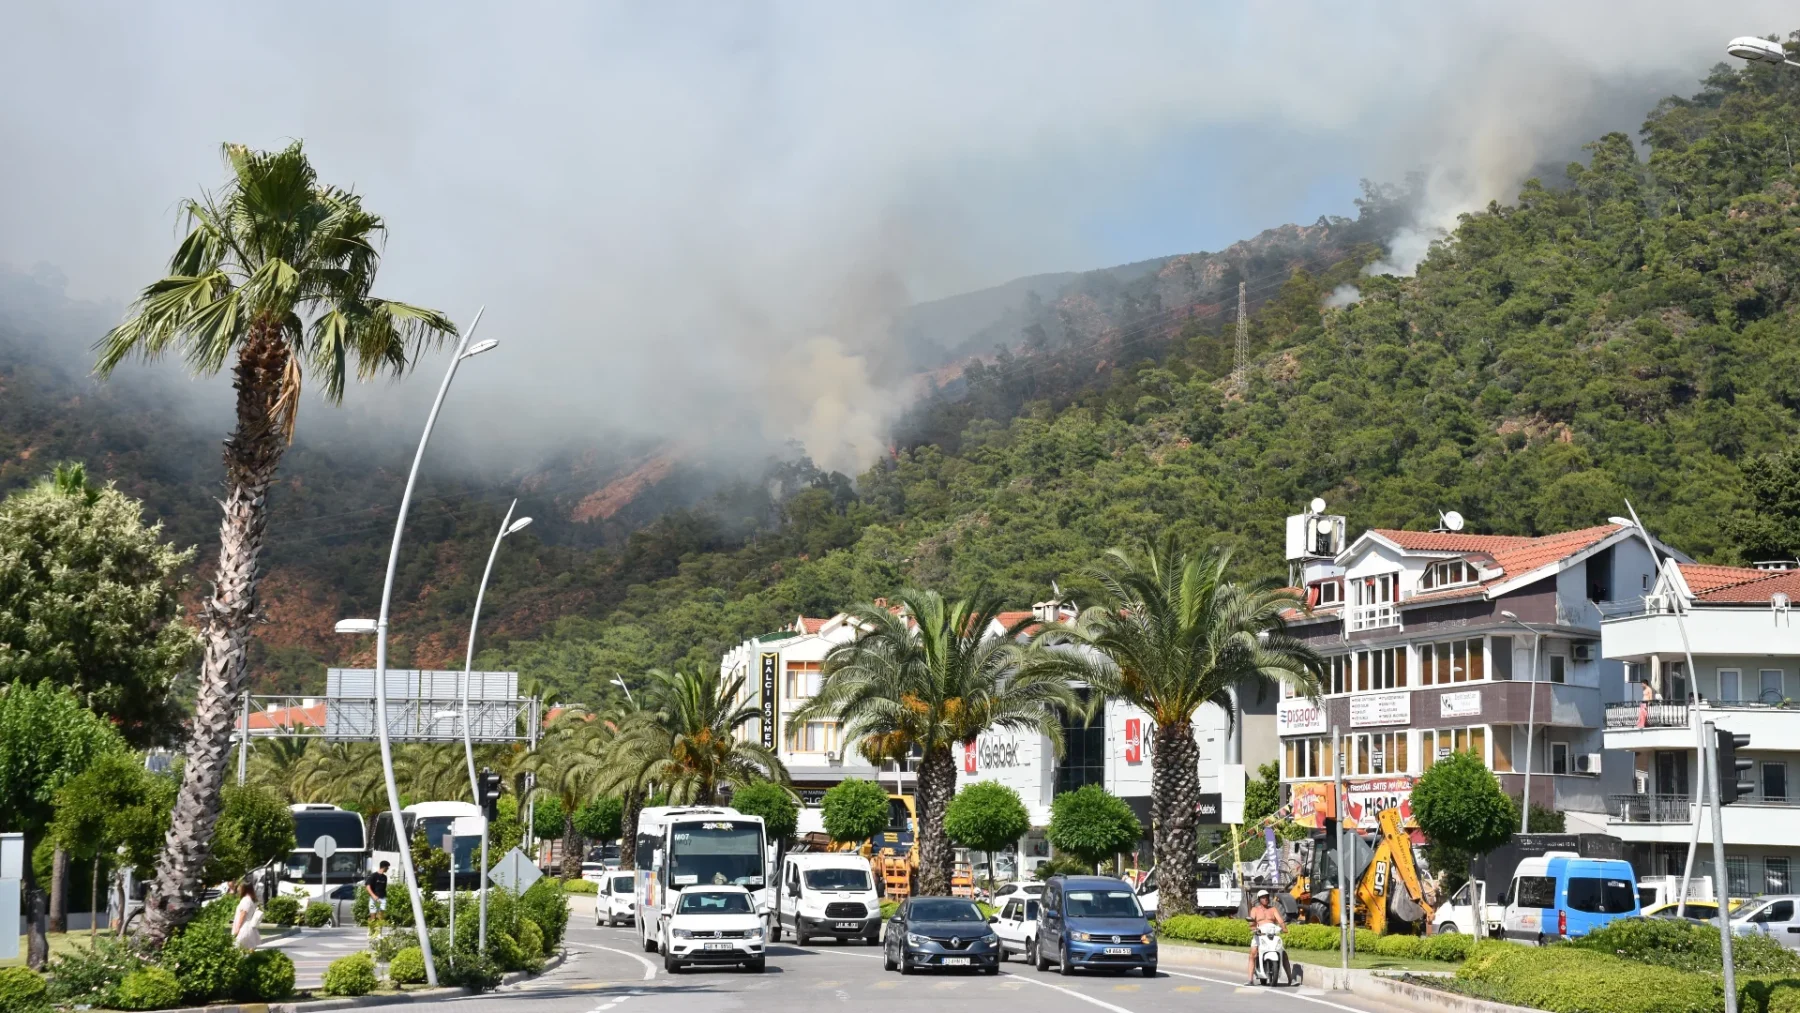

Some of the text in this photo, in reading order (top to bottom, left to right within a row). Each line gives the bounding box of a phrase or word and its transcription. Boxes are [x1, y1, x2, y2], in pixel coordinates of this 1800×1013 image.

[764, 702, 772, 748] GÖKMEN
[978, 735, 1018, 768] Kelebek
[674, 833, 690, 841] M07
[1374, 861, 1386, 896] JCB
